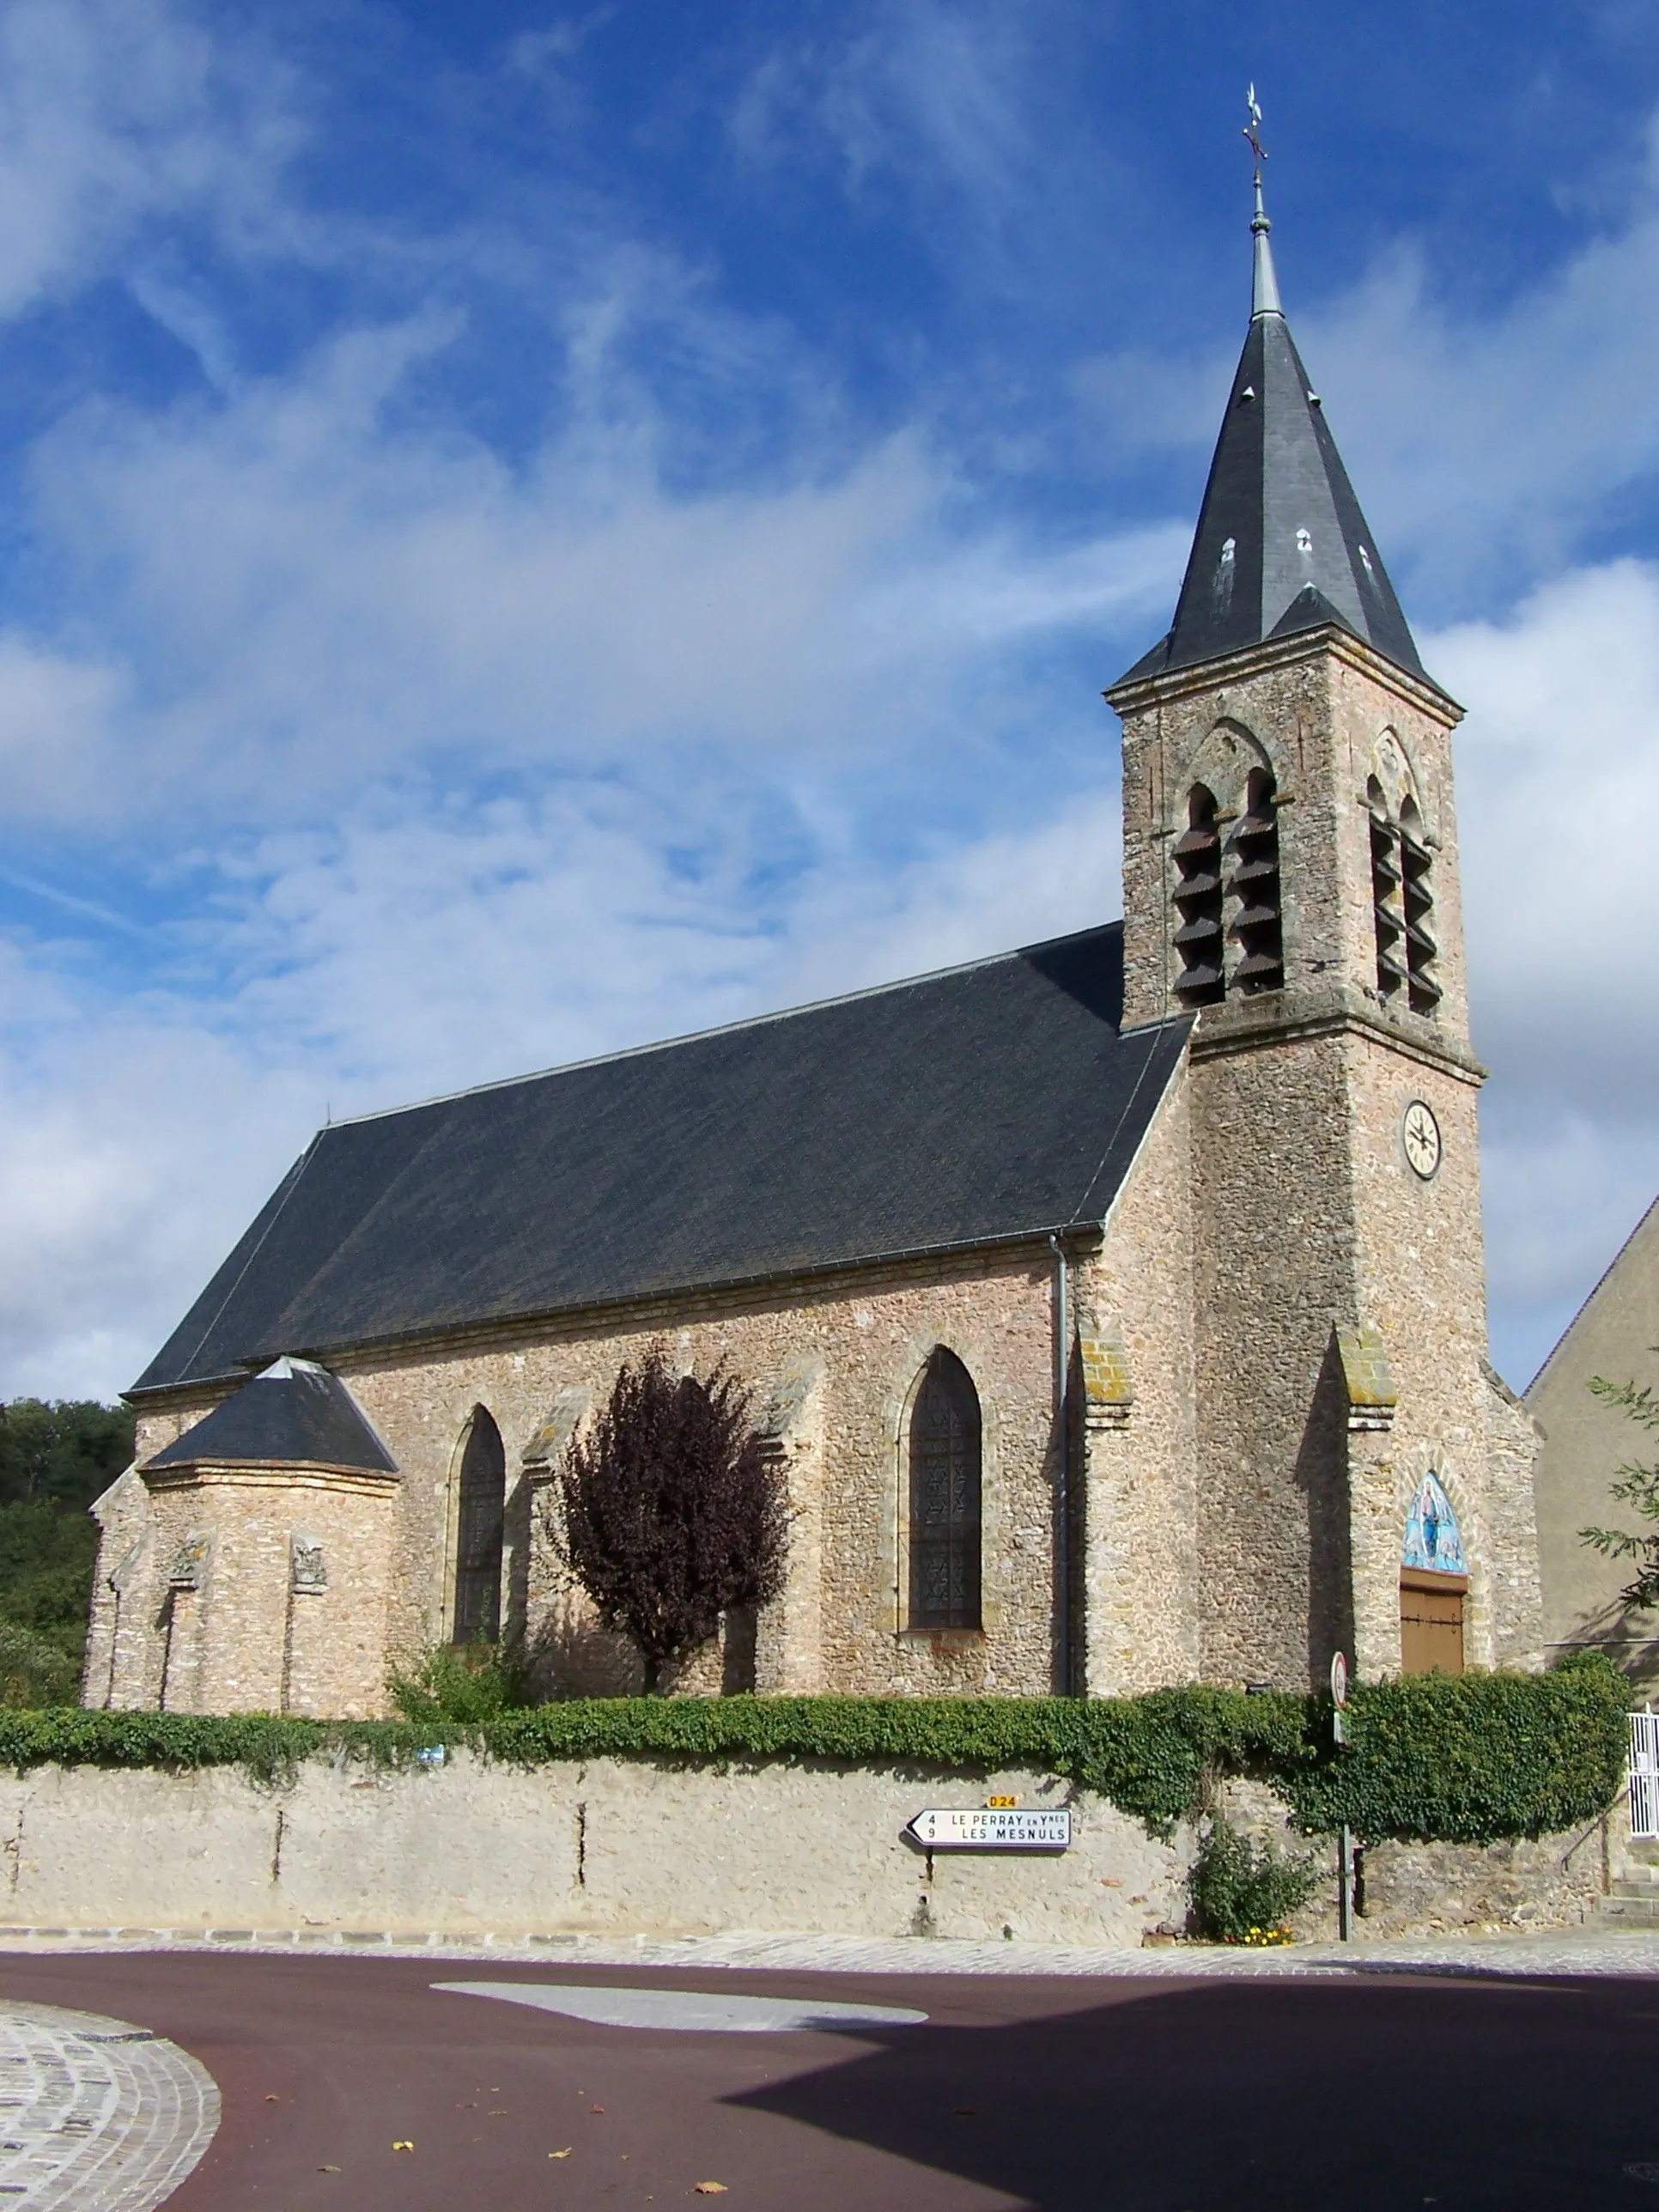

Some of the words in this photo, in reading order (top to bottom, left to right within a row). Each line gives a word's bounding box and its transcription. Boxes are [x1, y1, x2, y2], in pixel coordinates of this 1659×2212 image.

[990, 1796, 997, 1807] D
[1000, 1796, 1016, 1807] 24
[928, 1814, 936, 1825] 4
[951, 1814, 966, 1826] LE
[973, 1814, 1024, 1826] PERRAY
[928, 1827, 936, 1838] 9
[962, 1828, 987, 1839] LES
[996, 1828, 1066, 1840] MESNULS
